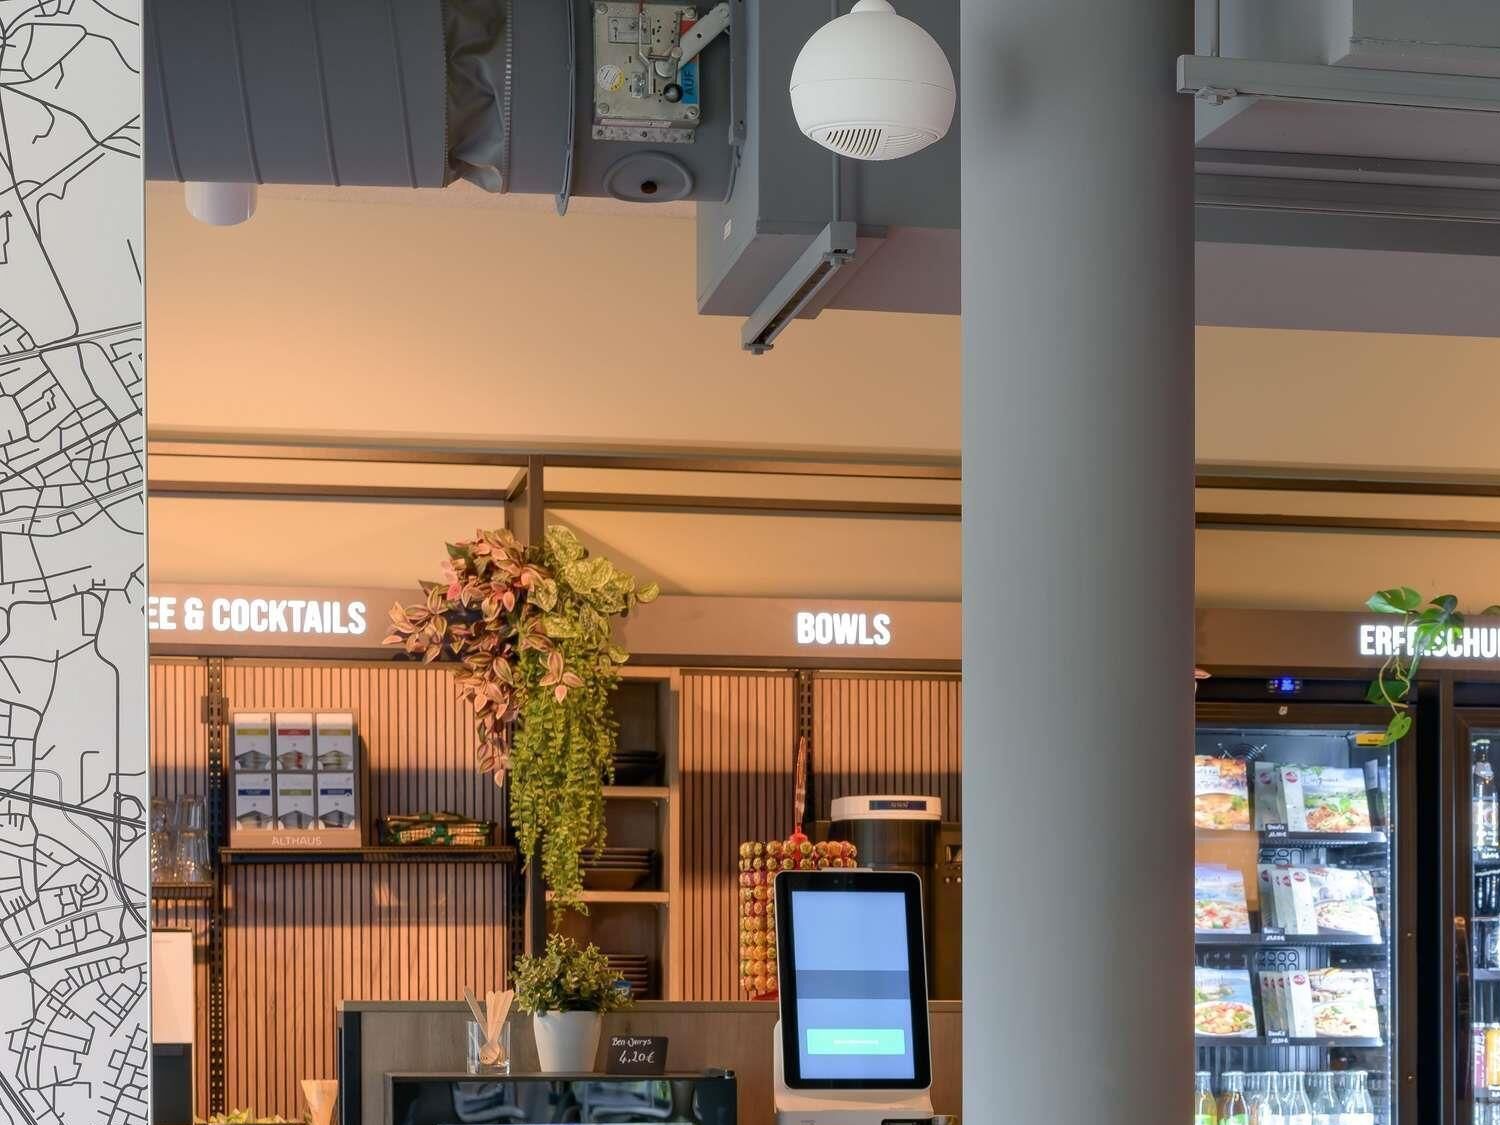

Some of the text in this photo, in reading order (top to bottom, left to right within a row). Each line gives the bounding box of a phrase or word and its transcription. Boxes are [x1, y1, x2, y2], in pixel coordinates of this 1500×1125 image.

[686, 70, 694, 97] AUF
[184, 597, 204, 631] &
[212, 599, 366, 634] COCKTAILS
[797, 612, 891, 645] BOWLS
[271, 836, 322, 846] ALTHAUS
